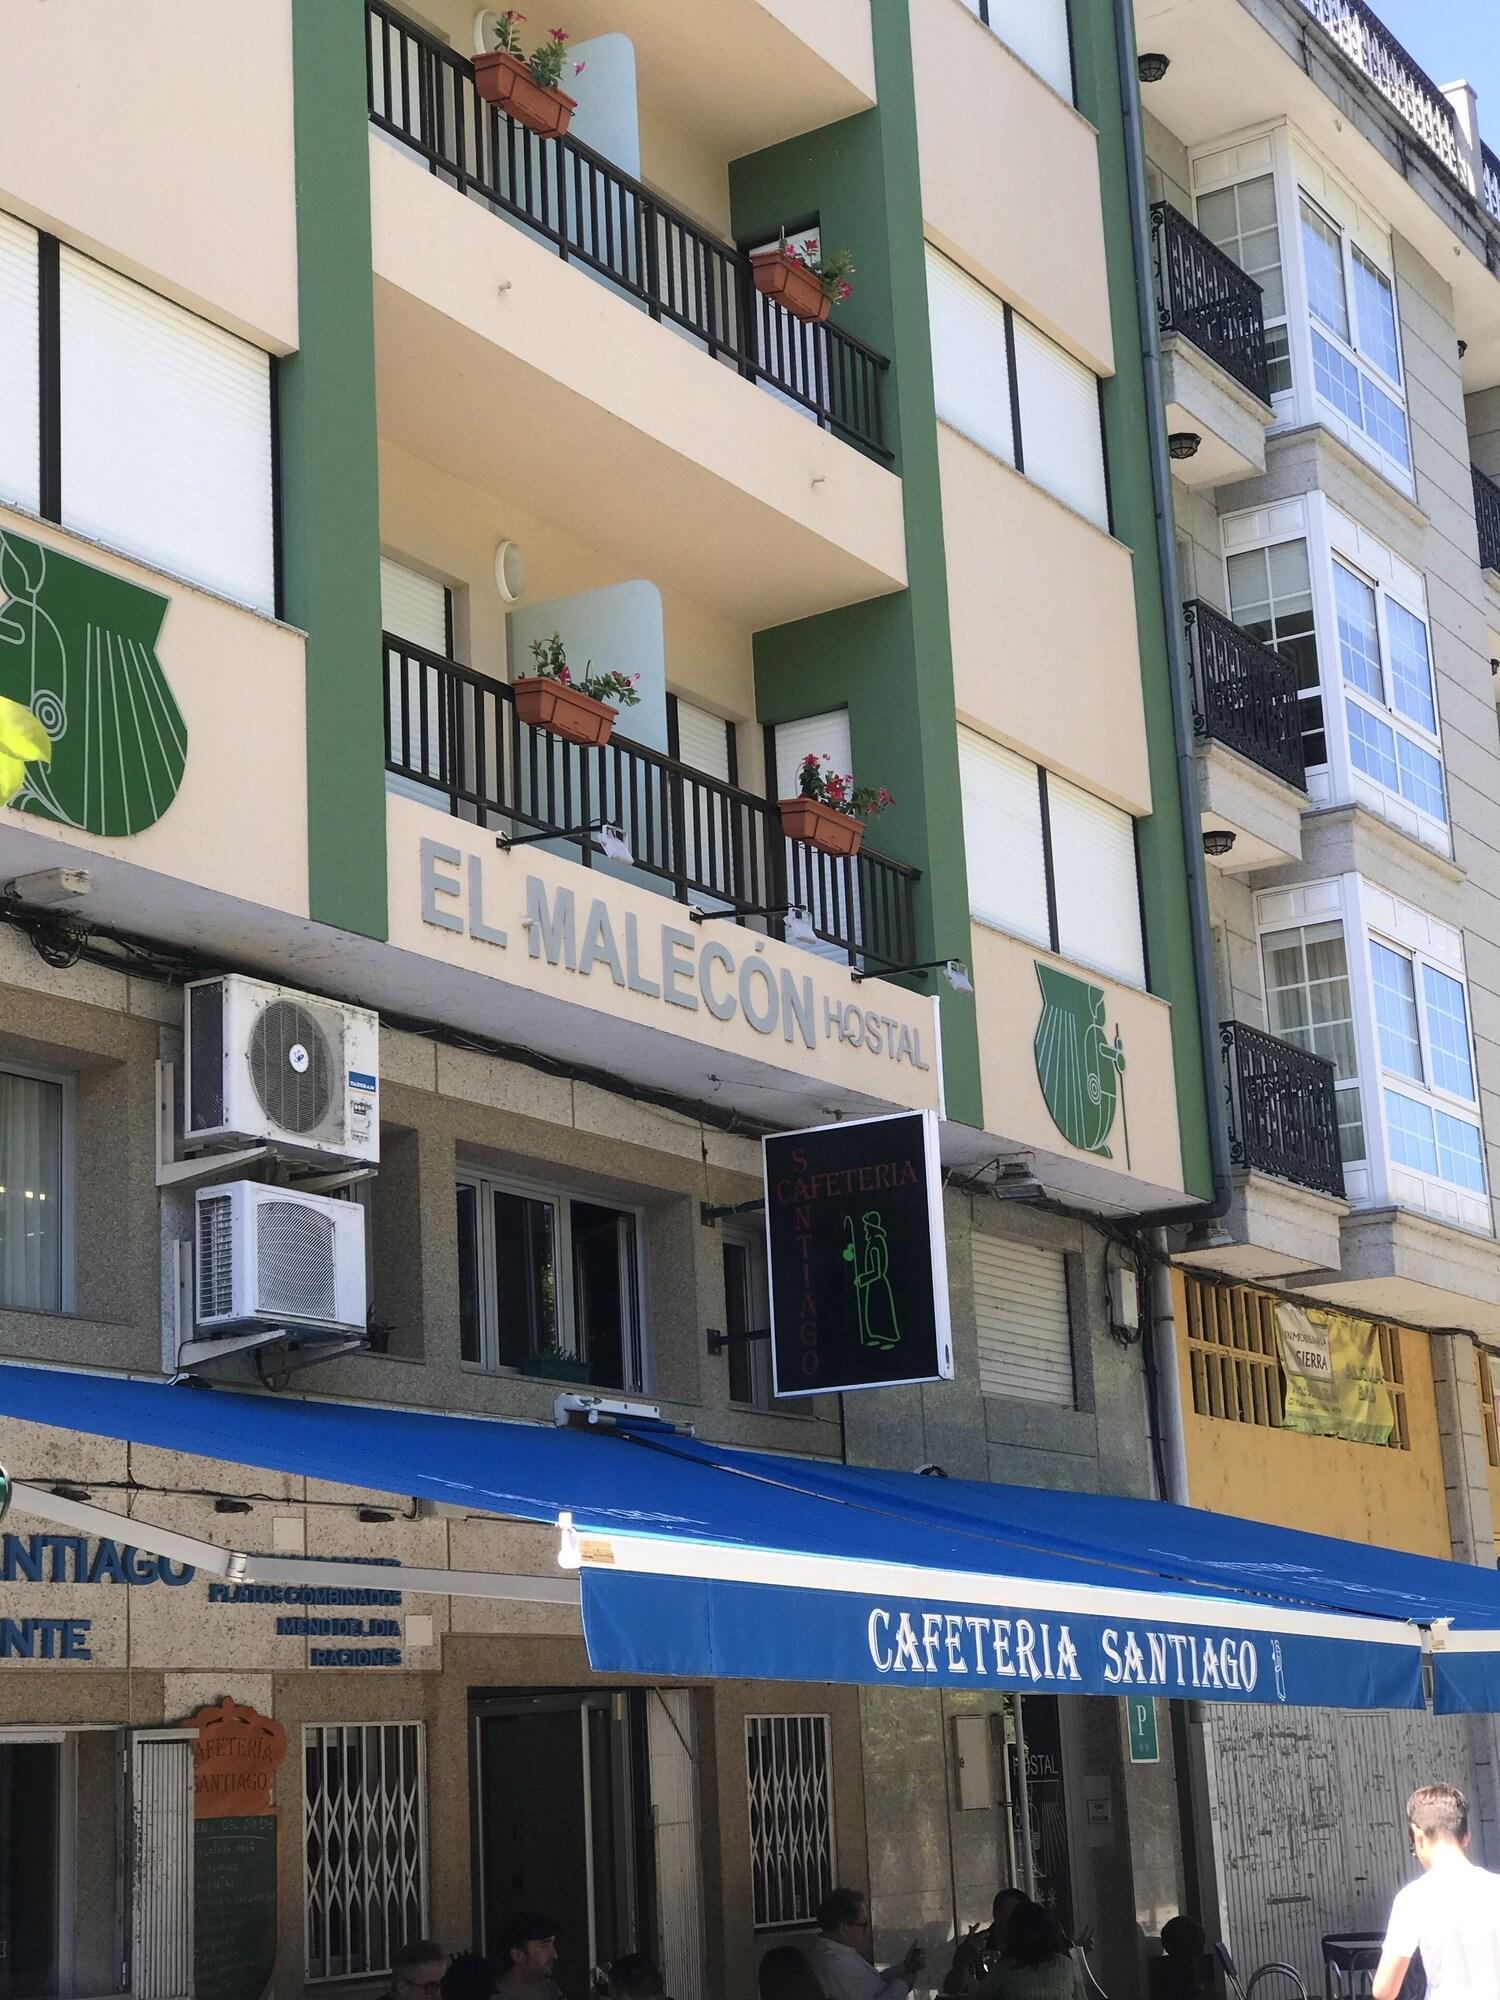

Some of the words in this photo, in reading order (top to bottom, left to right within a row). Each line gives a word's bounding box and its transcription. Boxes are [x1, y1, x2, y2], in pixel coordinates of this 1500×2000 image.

[420, 837, 507, 948] EL
[526, 875, 816, 1049] MALECÓN
[823, 996, 929, 1071] HOSTAL
[776, 1160, 919, 1204] CAFETERIA
[791, 1149, 818, 1376] SANTIAGO
[1296, 1350, 1328, 1371] SIERRA
[0, 1534, 196, 1586] NTIAGO
[208, 1583, 284, 1605] PLATOS
[285, 1585, 402, 1606] COMBINADOS
[0, 1617, 91, 1660] NTE
[277, 1616, 333, 1636] MENU
[334, 1617, 369, 1637] DEL
[369, 1619, 402, 1637] DIA
[310, 1648, 402, 1667] RACIONES
[868, 1608, 1081, 1682] CAFETERIA
[1102, 1628, 1257, 1693] SANTIAGO
[1136, 1704, 1147, 1736] P
[197, 1736, 273, 1763] AFETERÍA
